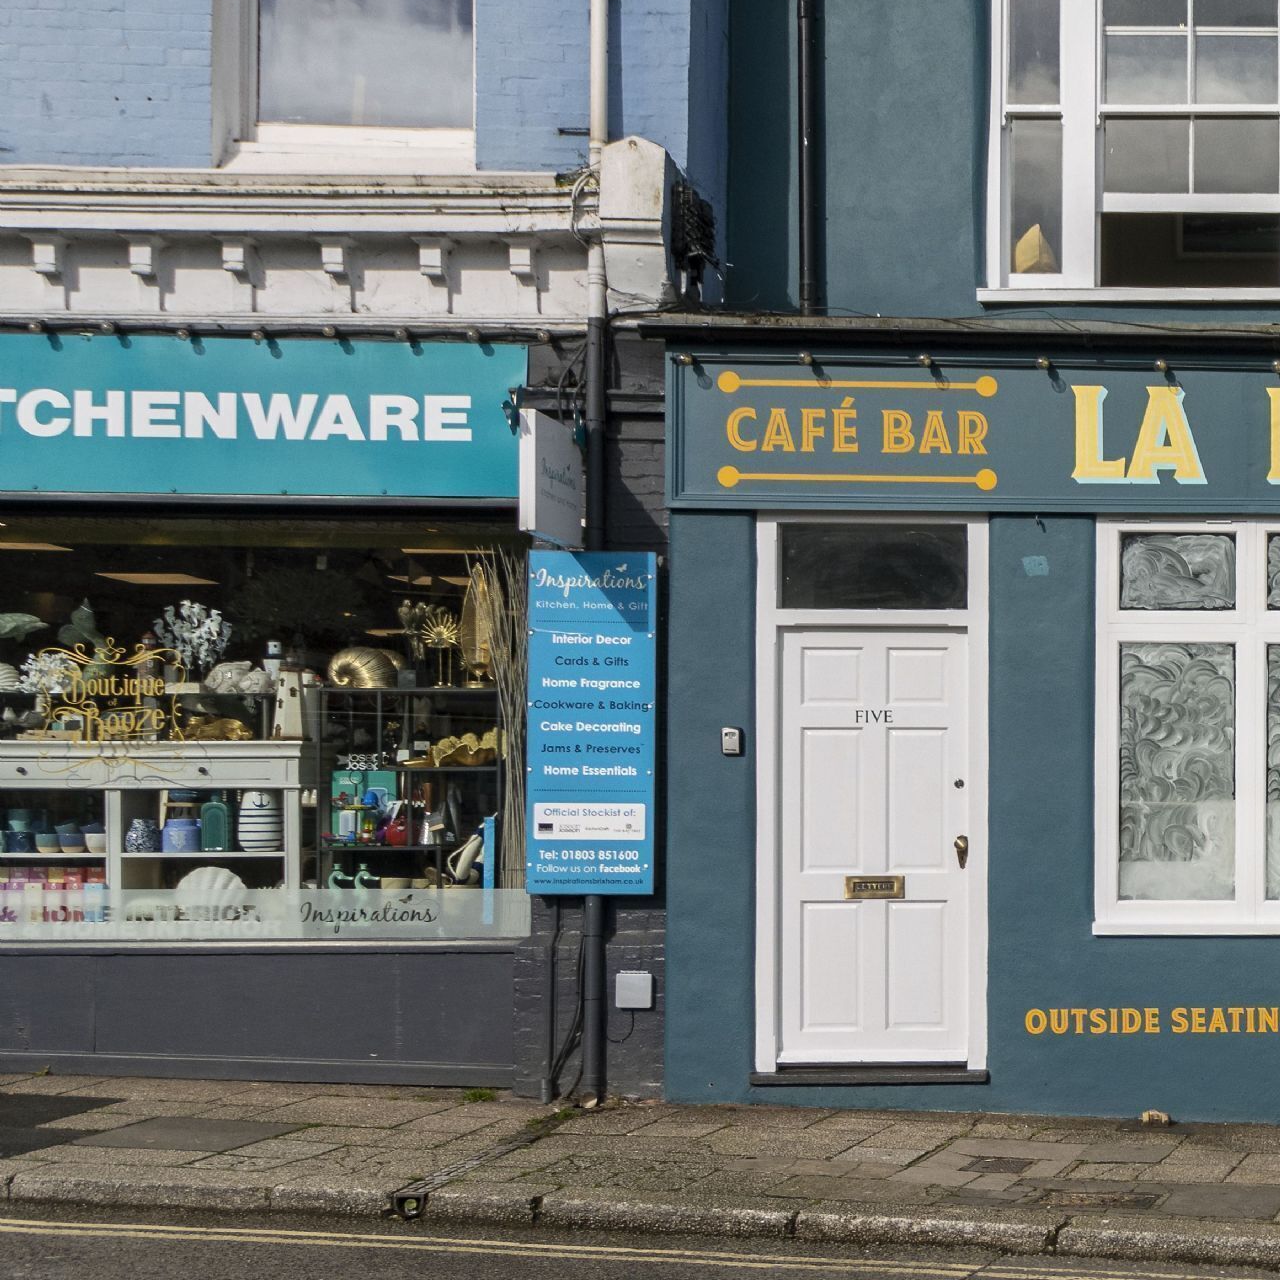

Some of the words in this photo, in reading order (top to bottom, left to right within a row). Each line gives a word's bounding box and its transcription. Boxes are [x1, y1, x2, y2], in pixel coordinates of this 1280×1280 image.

[725, 396, 860, 454] CAFÉ
[880, 409, 989, 456] BAR
[1070, 384, 1209, 485] LA
[536, 568, 648, 598] Inspirations
[583, 601, 614, 610] Home
[617, 602, 625, 610] &
[551, 633, 593, 645] Interior
[596, 635, 633, 645] Decor
[554, 655, 589, 666] Cards
[591, 657, 600, 666] &
[604, 656, 630, 667] Gifts
[62, 662, 166, 705] Boutique
[541, 677, 577, 688] Home
[580, 678, 641, 691] Fragrance
[532, 699, 594, 710] Cookware
[597, 701, 606, 710] &
[609, 700, 650, 713] Baking
[855, 710, 894, 724] FIVE
[53, 701, 166, 750] Booze
[540, 721, 573, 732] Cake
[575, 721, 641, 734] Decorating
[540, 743, 571, 753] Jams
[574, 744, 582, 753] &
[586, 743, 641, 754] Preserves
[543, 765, 579, 776] Home
[582, 765, 638, 776] Essentials
[543, 808, 580, 817] Official
[582, 808, 621, 817] Stockist
[623, 808, 637, 817] of:
[539, 849, 559, 860] Tel:
[561, 850, 596, 860] 01803
[598, 850, 639, 860] 851600
[536, 864, 569, 873] Follow
[599, 863, 641, 873] facebook
[300, 901, 438, 934] Inspirations
[1024, 1006, 1161, 1035] OUTSIDE
